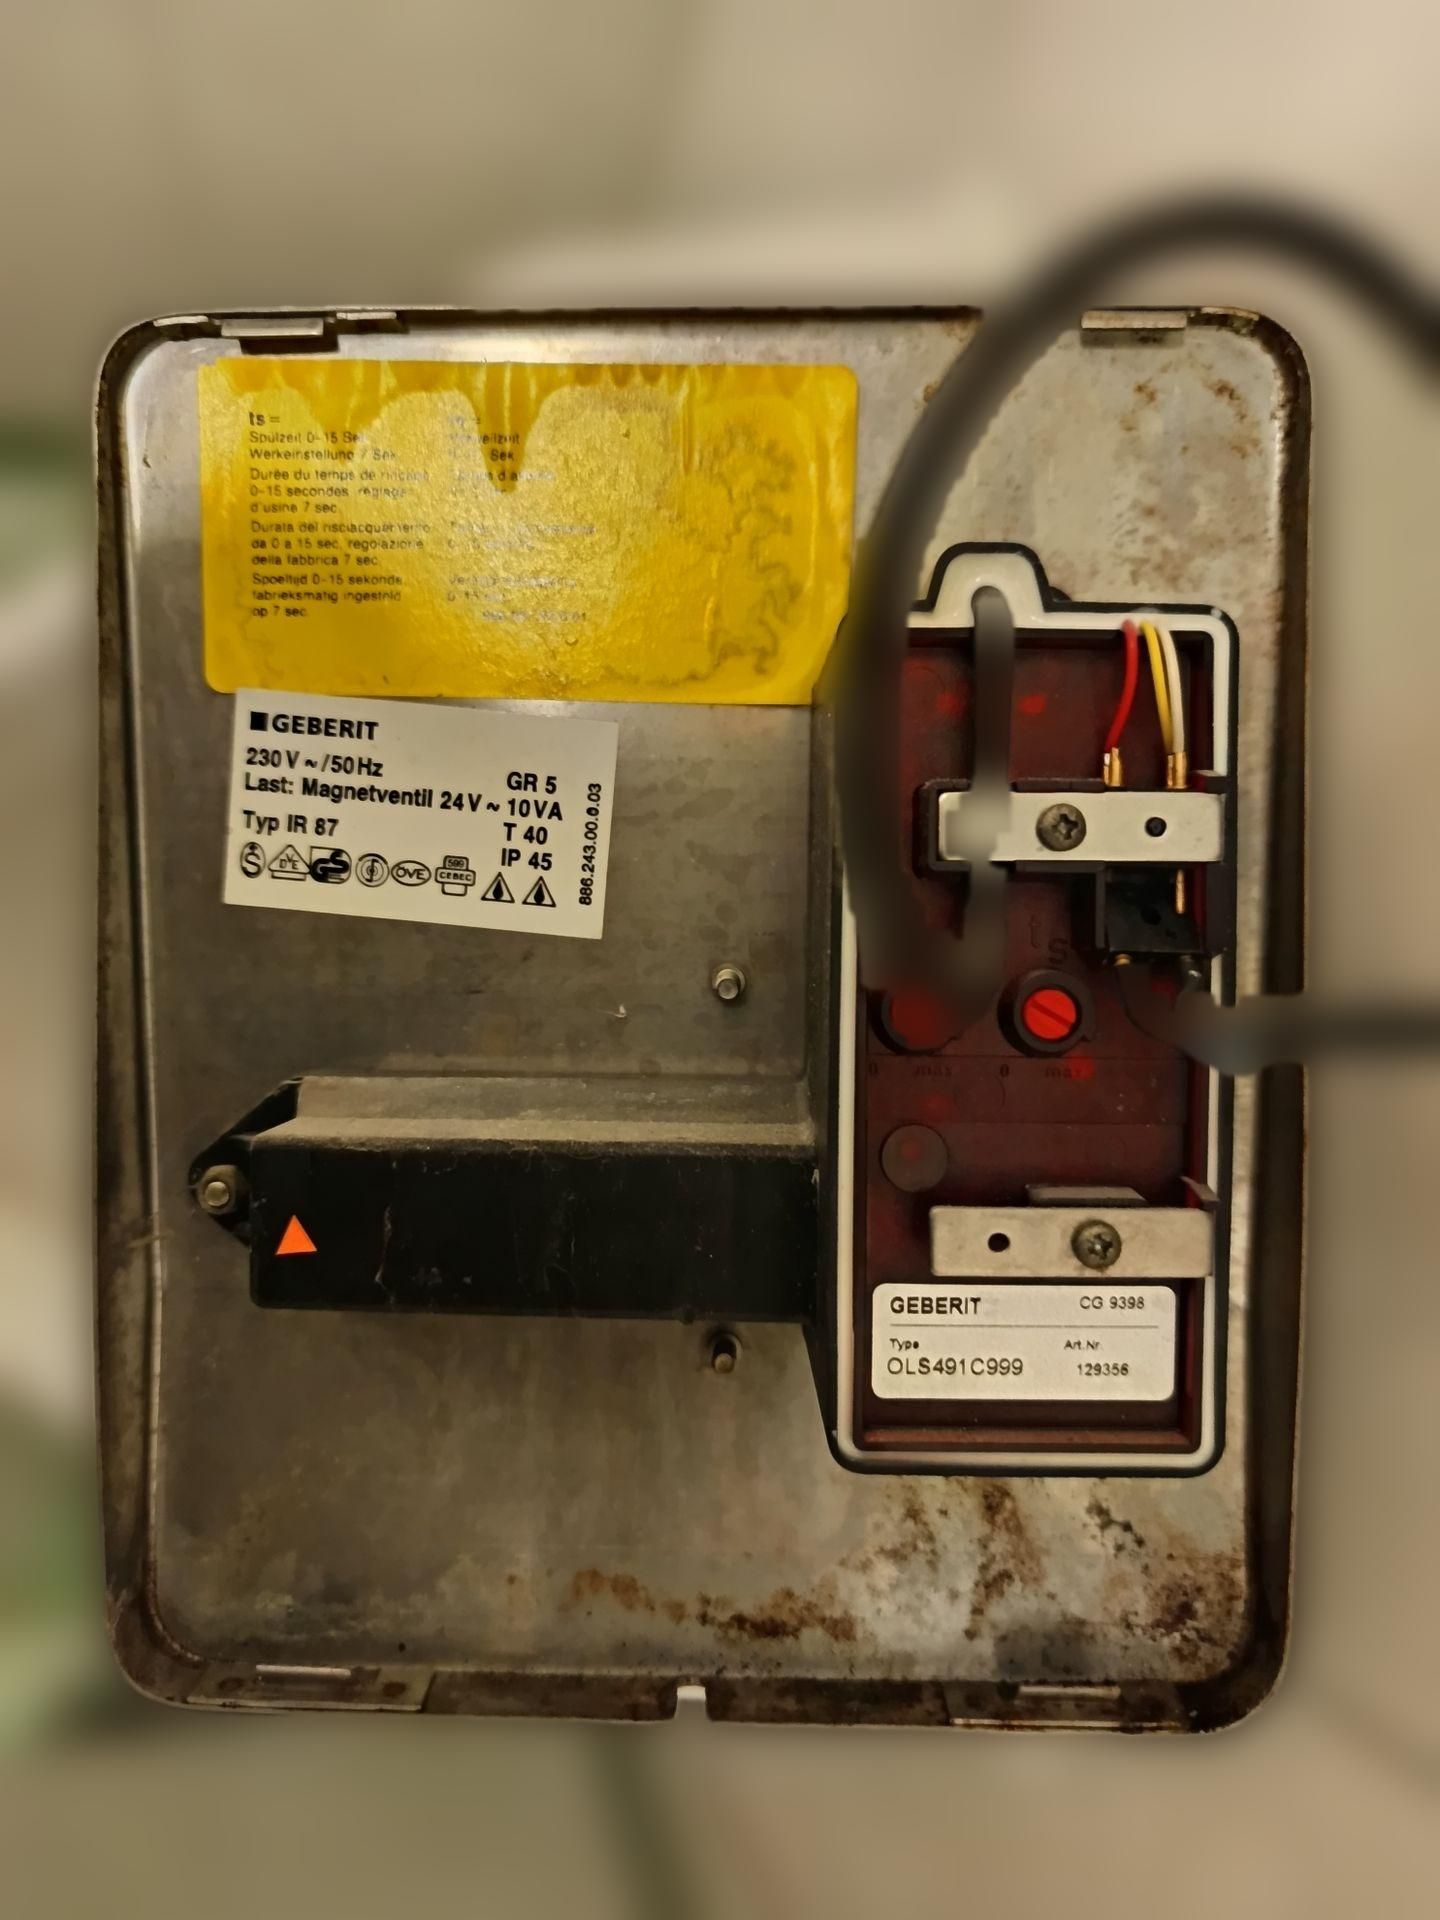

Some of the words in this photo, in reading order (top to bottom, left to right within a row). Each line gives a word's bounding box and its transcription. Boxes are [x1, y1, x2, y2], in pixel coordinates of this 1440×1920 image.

[294, 468, 310, 481] du
[360, 468, 376, 481] de
[304, 501, 311, 512] 7
[251, 520, 294, 533] Durata
[299, 520, 319, 532] del
[251, 538, 267, 549] da
[284, 540, 292, 549] a
[297, 538, 313, 549] 15
[251, 554, 282, 565] della
[286, 554, 339, 566] fabbrica
[344, 554, 351, 565] 7
[251, 607, 268, 619] op
[272, 606, 280, 616] 7
[272, 713, 379, 741] GEBERIT
[506, 771, 538, 793] GR
[544, 775, 557, 795] 5
[245, 772, 294, 795] Last:
[302, 777, 434, 810] Magnetventil
[243, 809, 280, 836] Typ
[287, 814, 308, 834] IR
[314, 817, 339, 837] 87
[503, 822, 517, 841] T
[523, 826, 548, 845] 40
[578, 783, 602, 906] 886.243.00.0.03
[501, 848, 521, 867] IP
[528, 852, 553, 871] 45
[439, 871, 472, 882] CEBEC
[890, 1296, 982, 1315] GEBERIT
[1079, 1295, 1103, 1309] CG
[1109, 1296, 1145, 1309] 9398
[890, 1338, 920, 1351] Type
[887, 1357, 1024, 1376] OLS491C999
[1077, 1362, 1129, 1377] 129356
